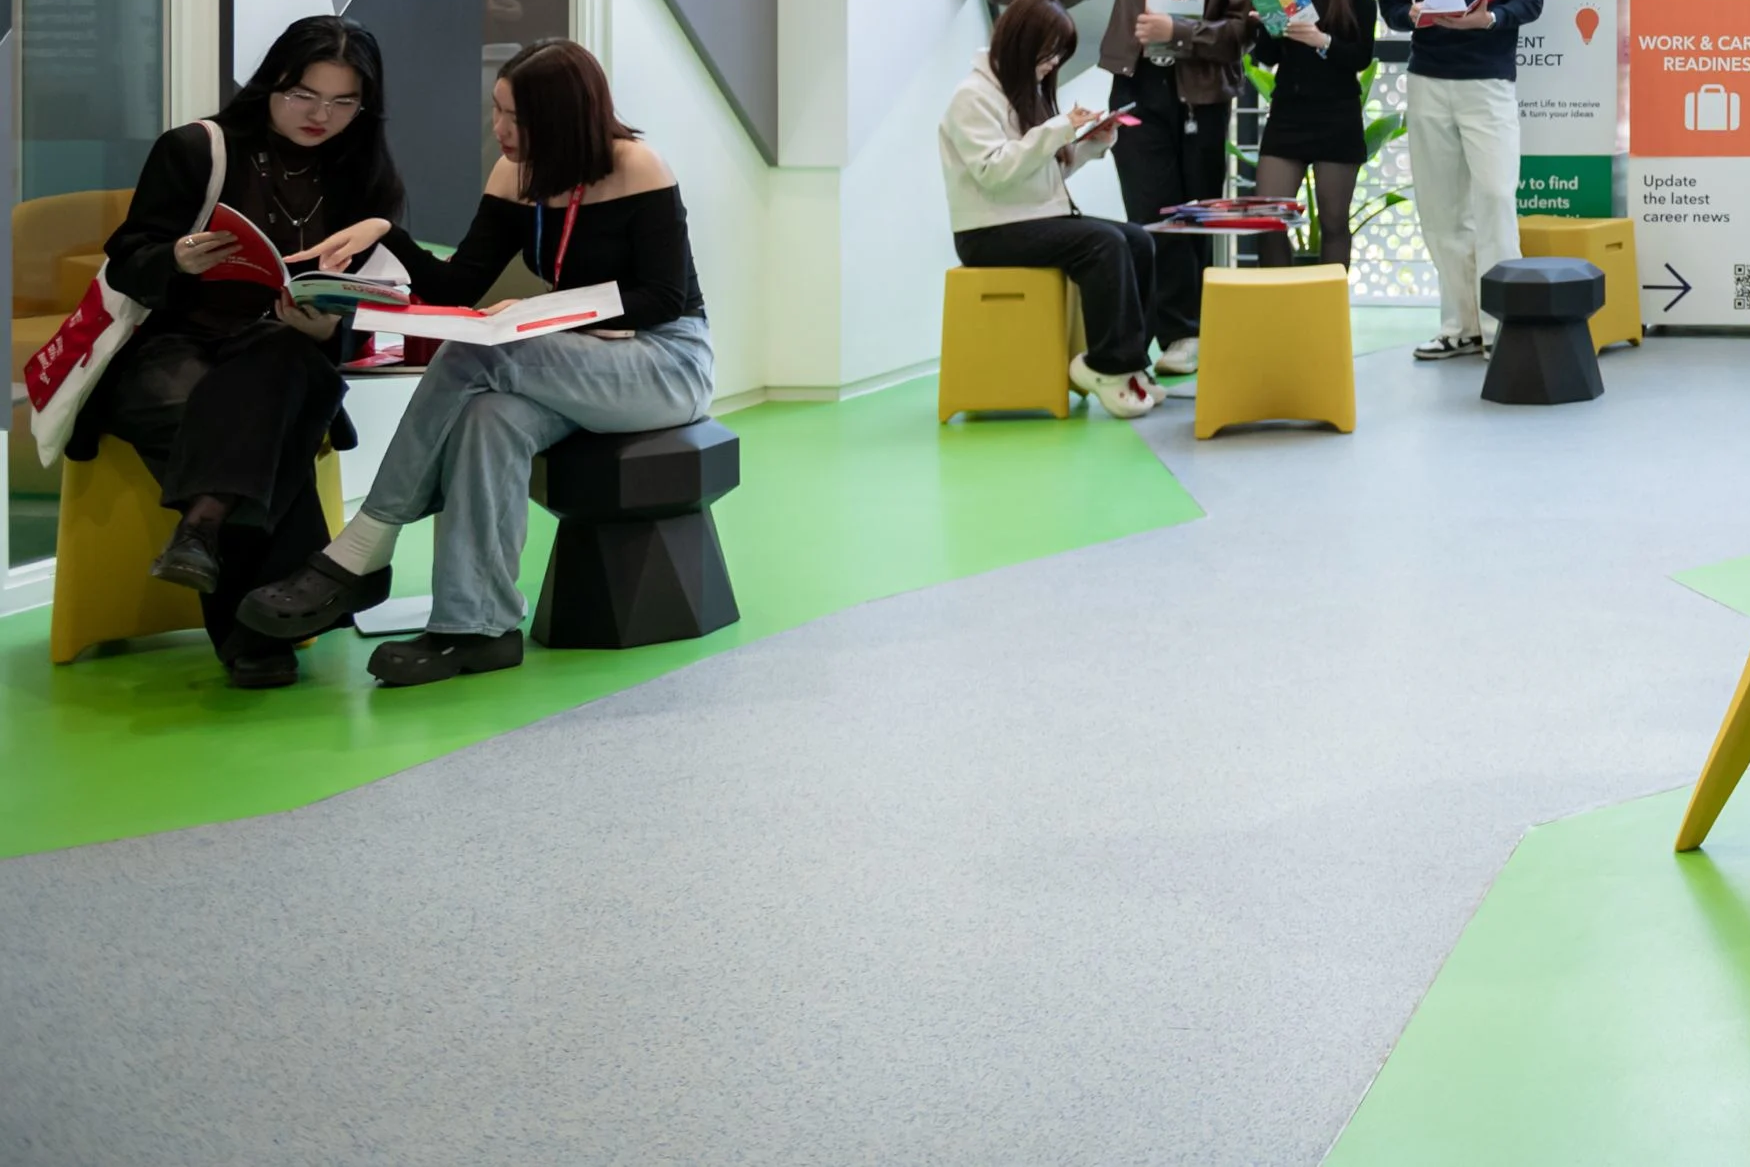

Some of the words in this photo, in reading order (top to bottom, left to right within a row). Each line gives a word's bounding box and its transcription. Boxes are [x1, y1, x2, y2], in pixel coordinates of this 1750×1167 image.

[1638, 36, 1696, 51] WORK
[1699, 36, 1713, 51] &
[1515, 54, 1564, 66] OJECT
[1518, 100, 1538, 108] dent
[1540, 99, 1556, 108] Life
[1558, 100, 1567, 108] to
[1569, 100, 1601, 108] receive
[1549, 111, 1569, 119] your
[1571, 110, 1594, 118] ideas
[1529, 178, 1545, 190] to
[1548, 175, 1579, 190] find
[1643, 174, 1697, 190] Update
[1518, 194, 1570, 209] udents
[1643, 193, 1666, 205] the
[1671, 192, 1710, 205] latest
[1643, 213, 1688, 223] career
[1693, 213, 1730, 223] news
